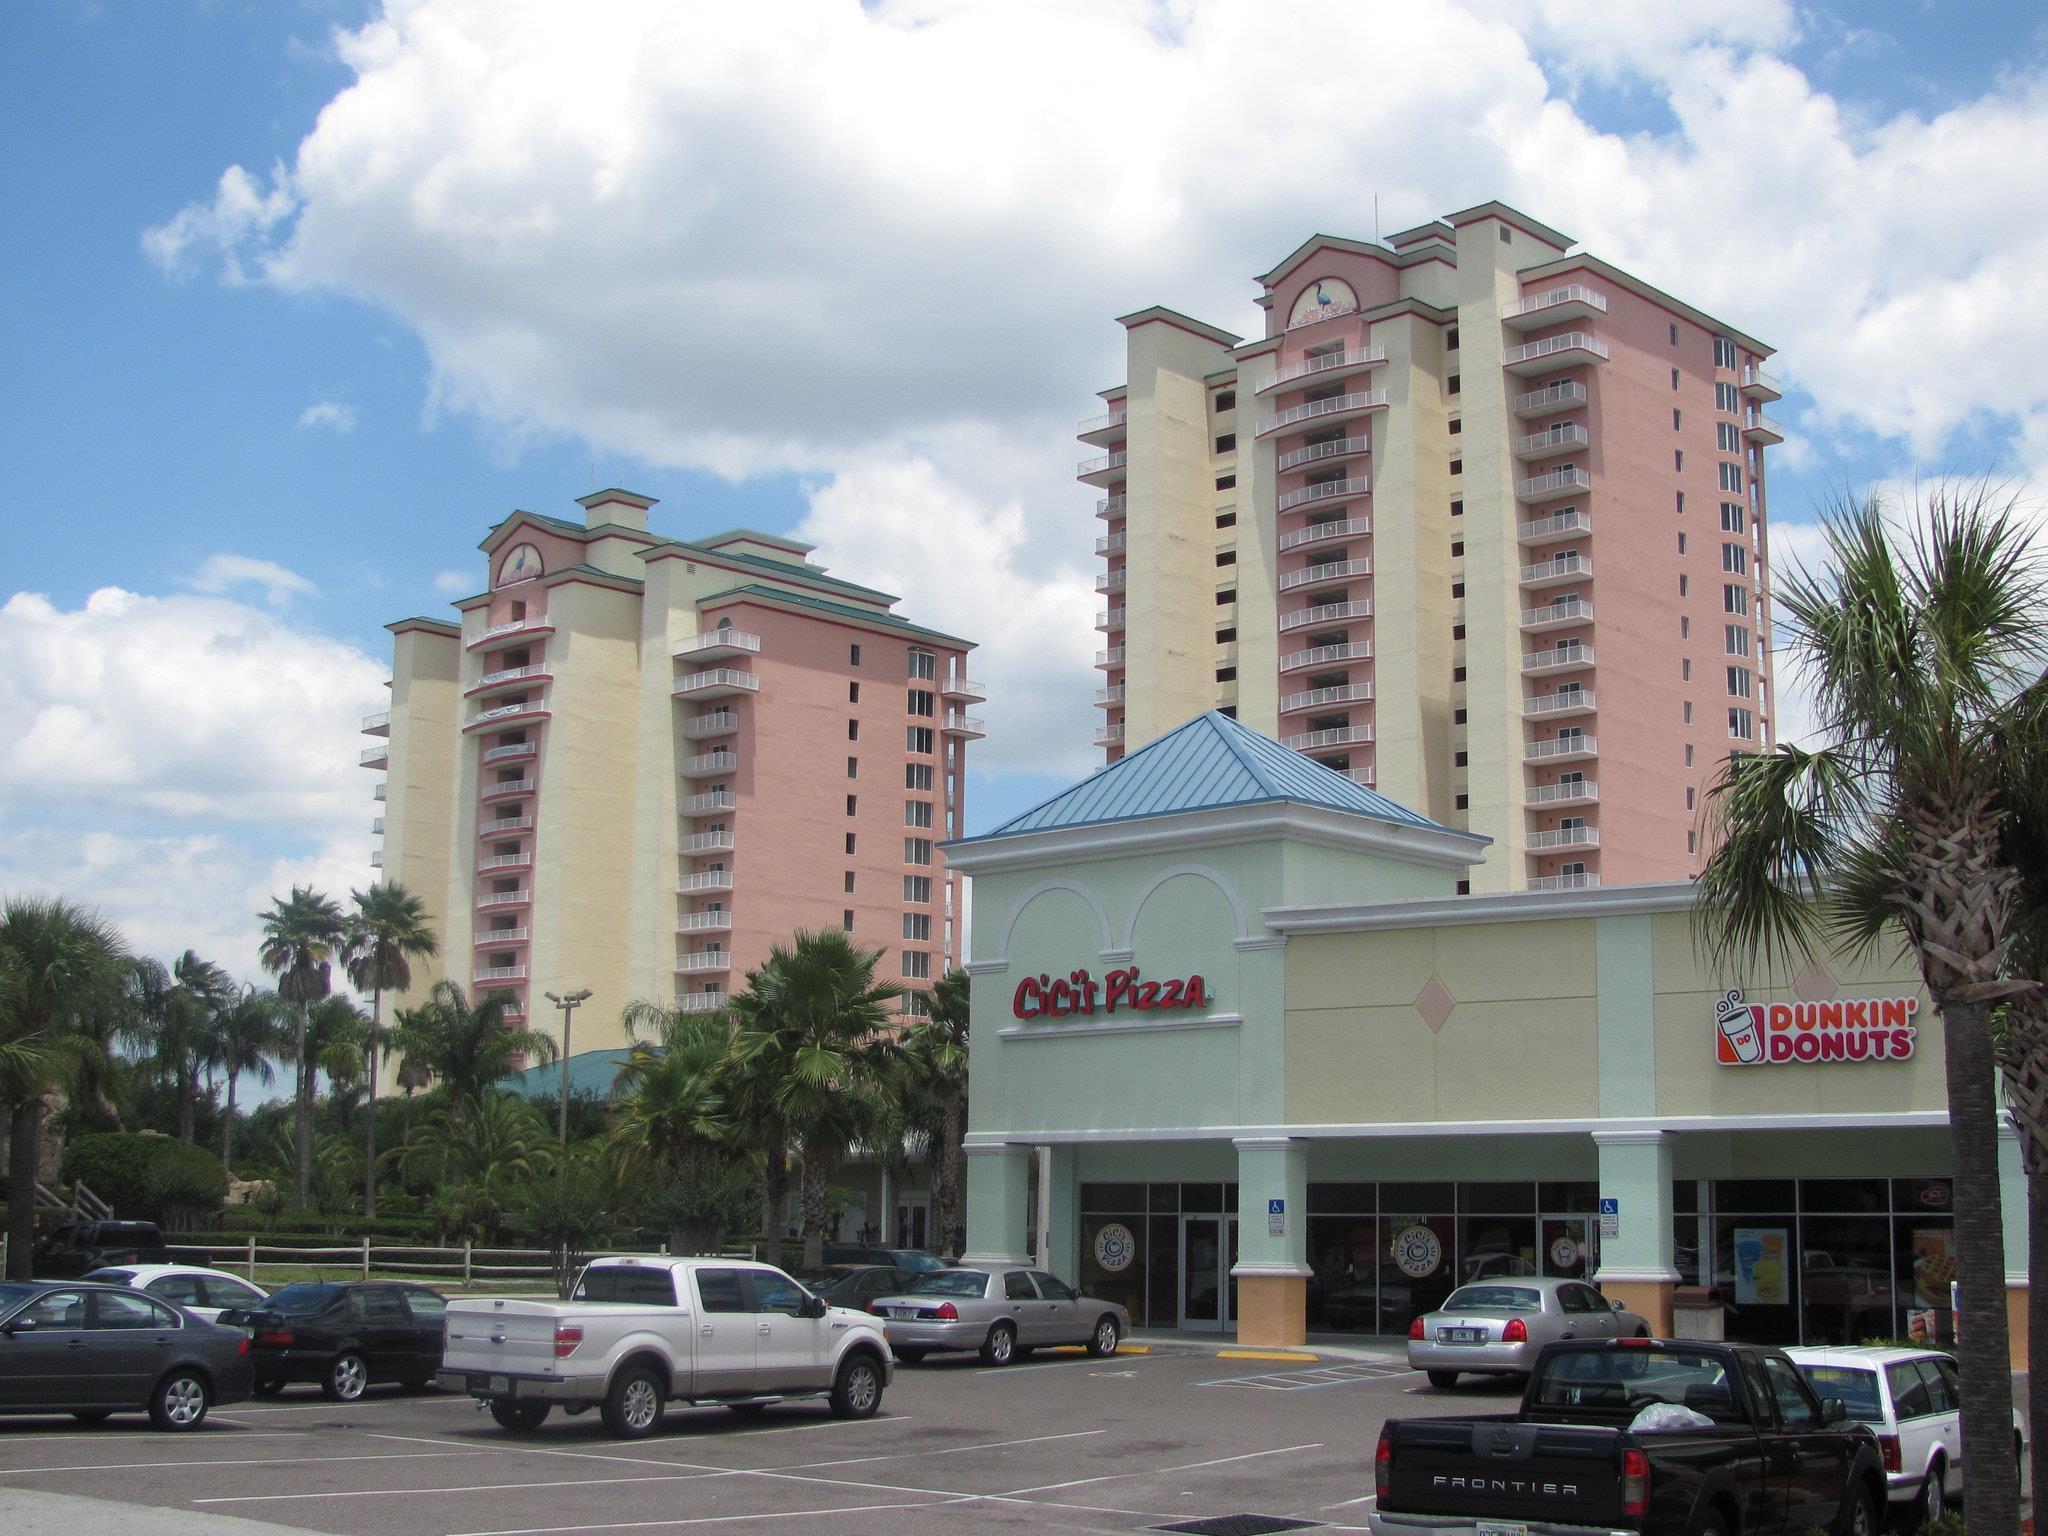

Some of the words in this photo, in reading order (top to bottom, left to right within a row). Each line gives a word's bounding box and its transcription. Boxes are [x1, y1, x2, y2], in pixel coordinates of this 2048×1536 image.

[1769, 999, 1916, 1031] DUNKIN'
[1736, 1035, 1751, 1045] DD
[1770, 1029, 1911, 1061] DONUTS
[1433, 1476, 1578, 1496] FRONTIER
